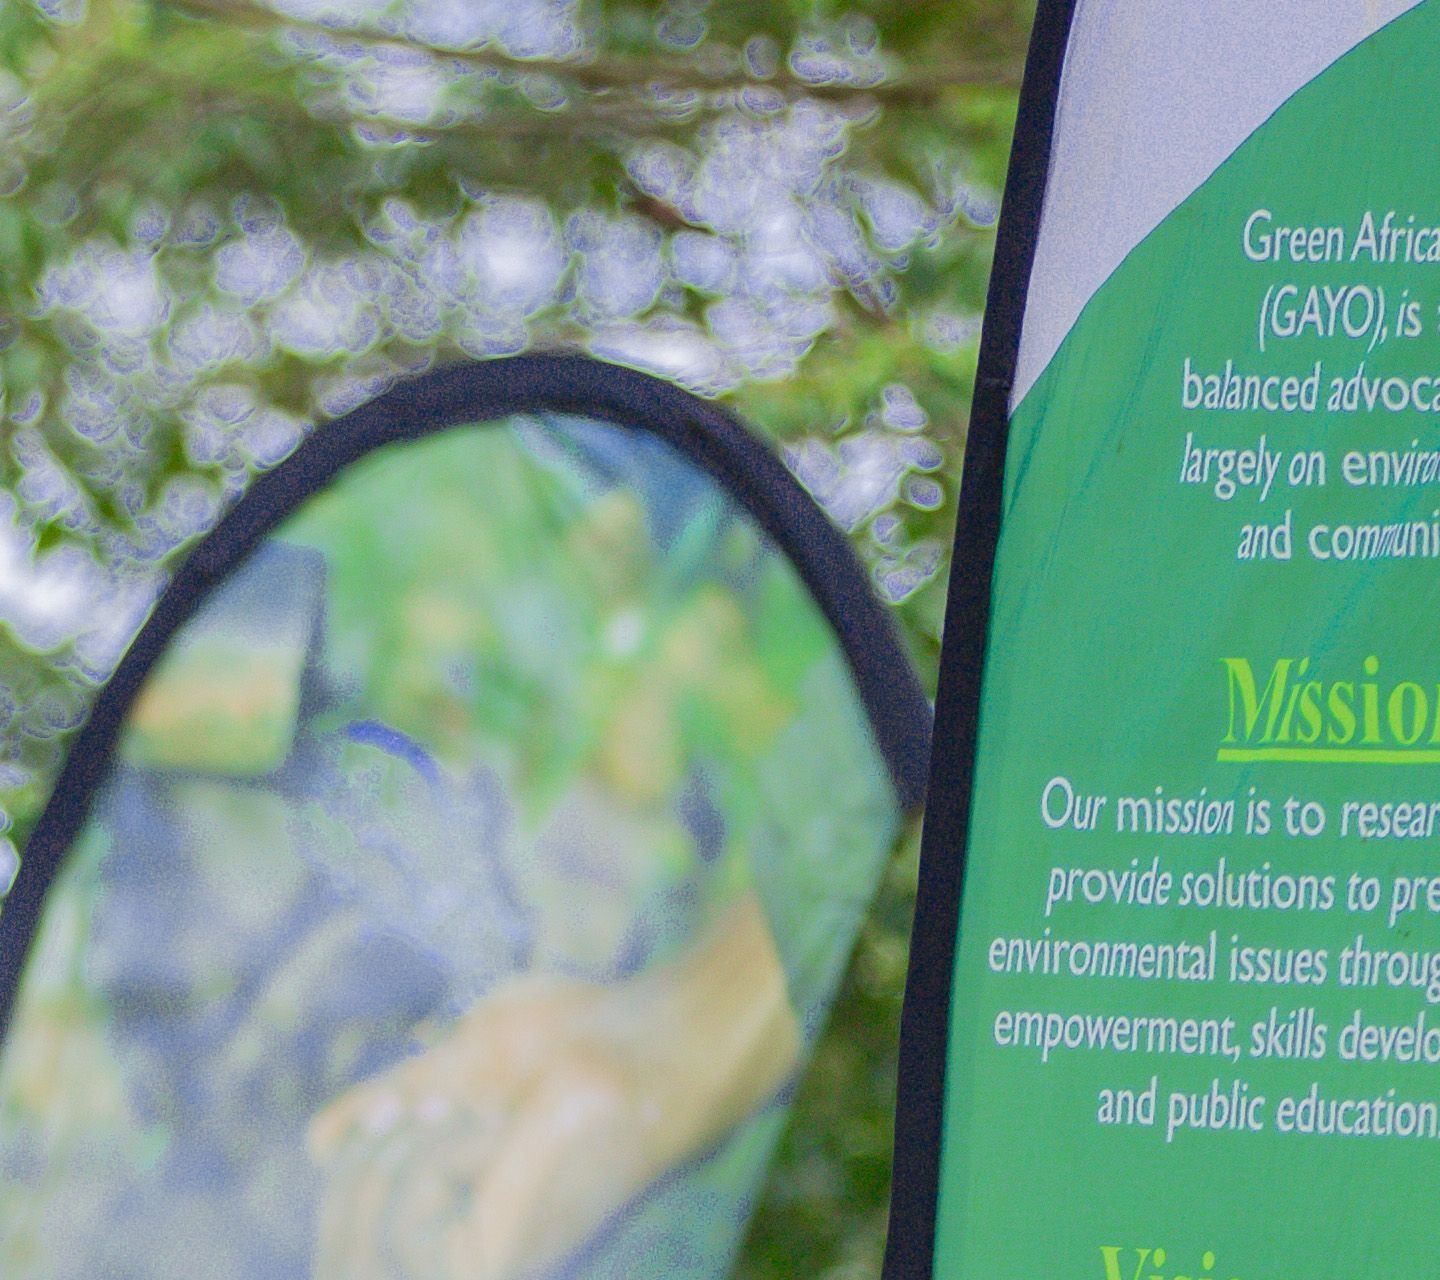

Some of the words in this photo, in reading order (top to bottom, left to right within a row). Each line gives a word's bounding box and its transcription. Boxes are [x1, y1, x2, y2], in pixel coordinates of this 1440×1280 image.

[1242, 209, 1344, 262] Green
[1258, 285, 1387, 353] (GAYO),
[1395, 289, 1422, 337] is
[1182, 357, 1322, 412] balanced
[1180, 431, 1281, 502] largely
[1288, 451, 1325, 486] on
[1237, 509, 1291, 560] and
[1041, 777, 1105, 829] Our
[1116, 786, 1235, 835] mission
[1246, 787, 1271, 835] is
[1284, 794, 1326, 837] to
[1046, 857, 1173, 916] provide
[1179, 858, 1336, 911] solutions
[1347, 871, 1381, 911] to
[988, 928, 1217, 981] environmental
[1228, 933, 1328, 987] issues
[993, 1009, 1241, 1064] empowerment,
[1251, 1006, 1328, 1060] skills
[1097, 1075, 1158, 1126] and
[1166, 1078, 1266, 1142] public
